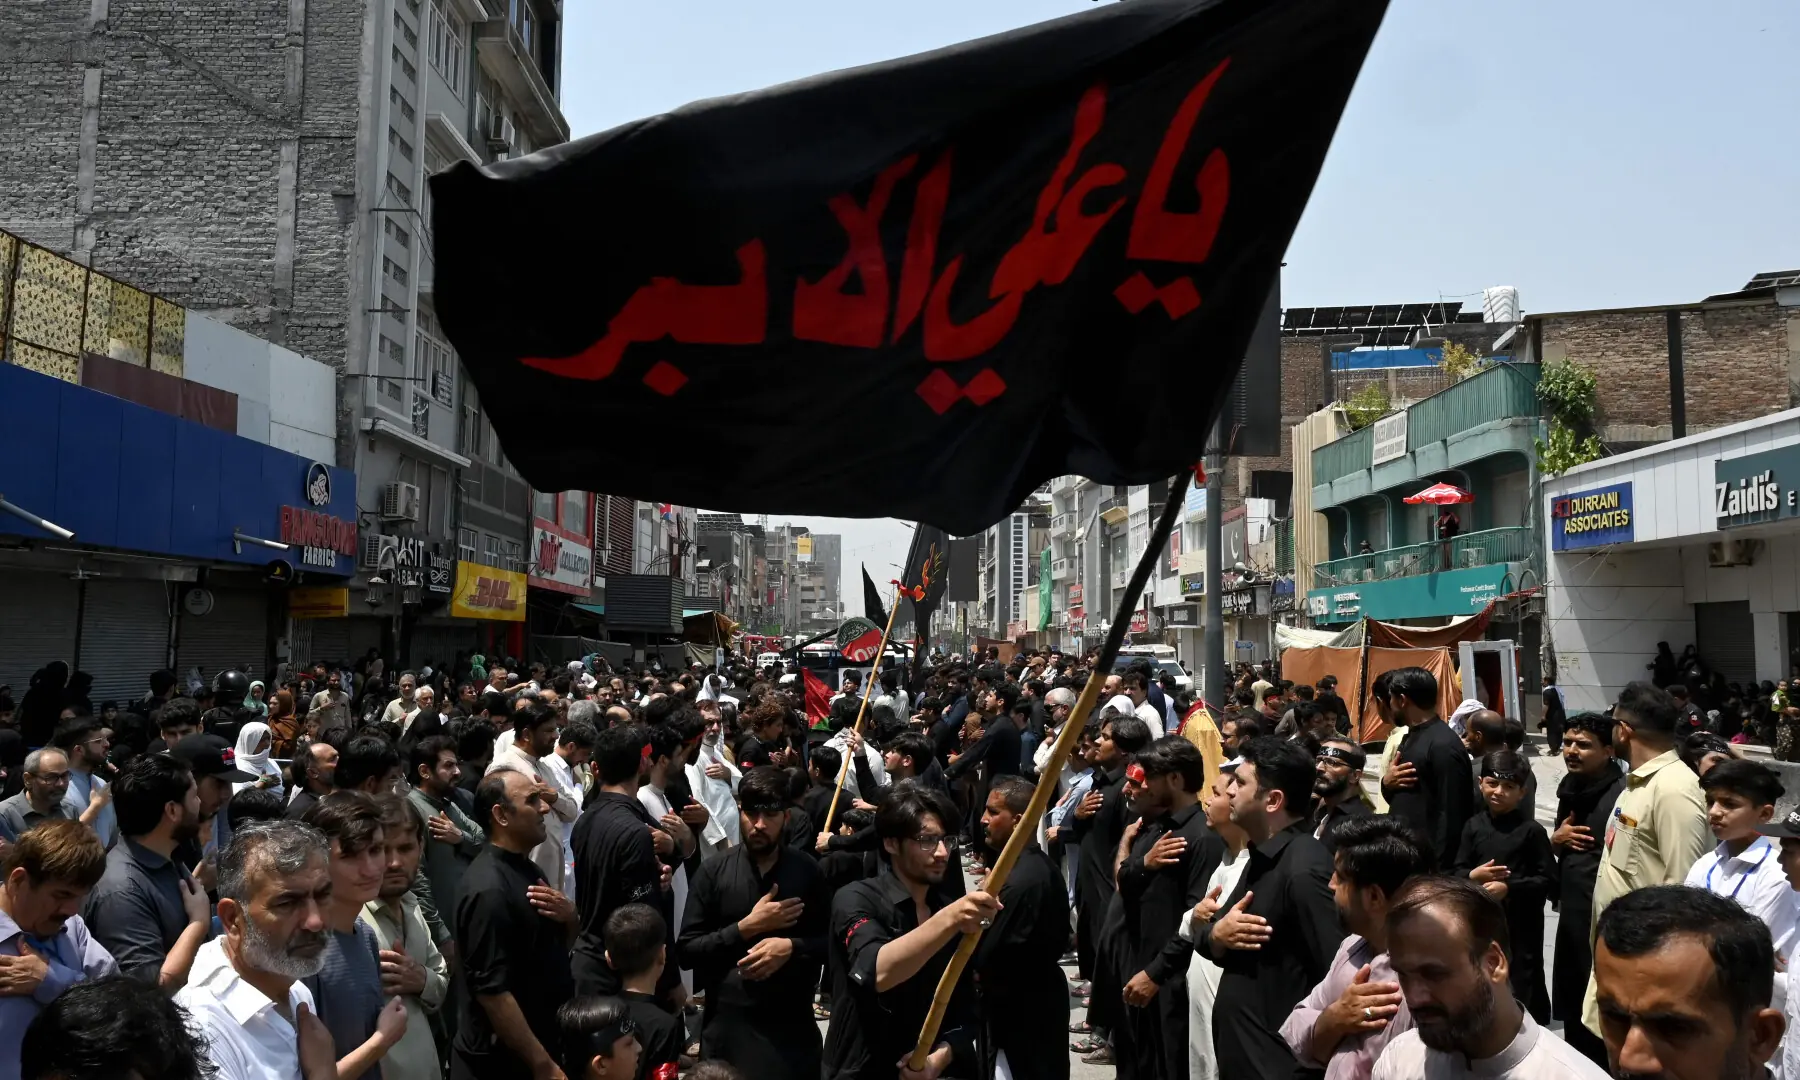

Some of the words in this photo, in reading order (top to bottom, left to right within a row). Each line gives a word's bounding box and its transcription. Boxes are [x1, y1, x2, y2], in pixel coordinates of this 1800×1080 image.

[1571, 491, 1619, 515] DURRANI
[1715, 469, 1778, 518] Zaidi's
[1564, 509, 1629, 534] ASSOCIATES
[303, 545, 336, 568] FABRICS
[473, 576, 518, 610] DHL
